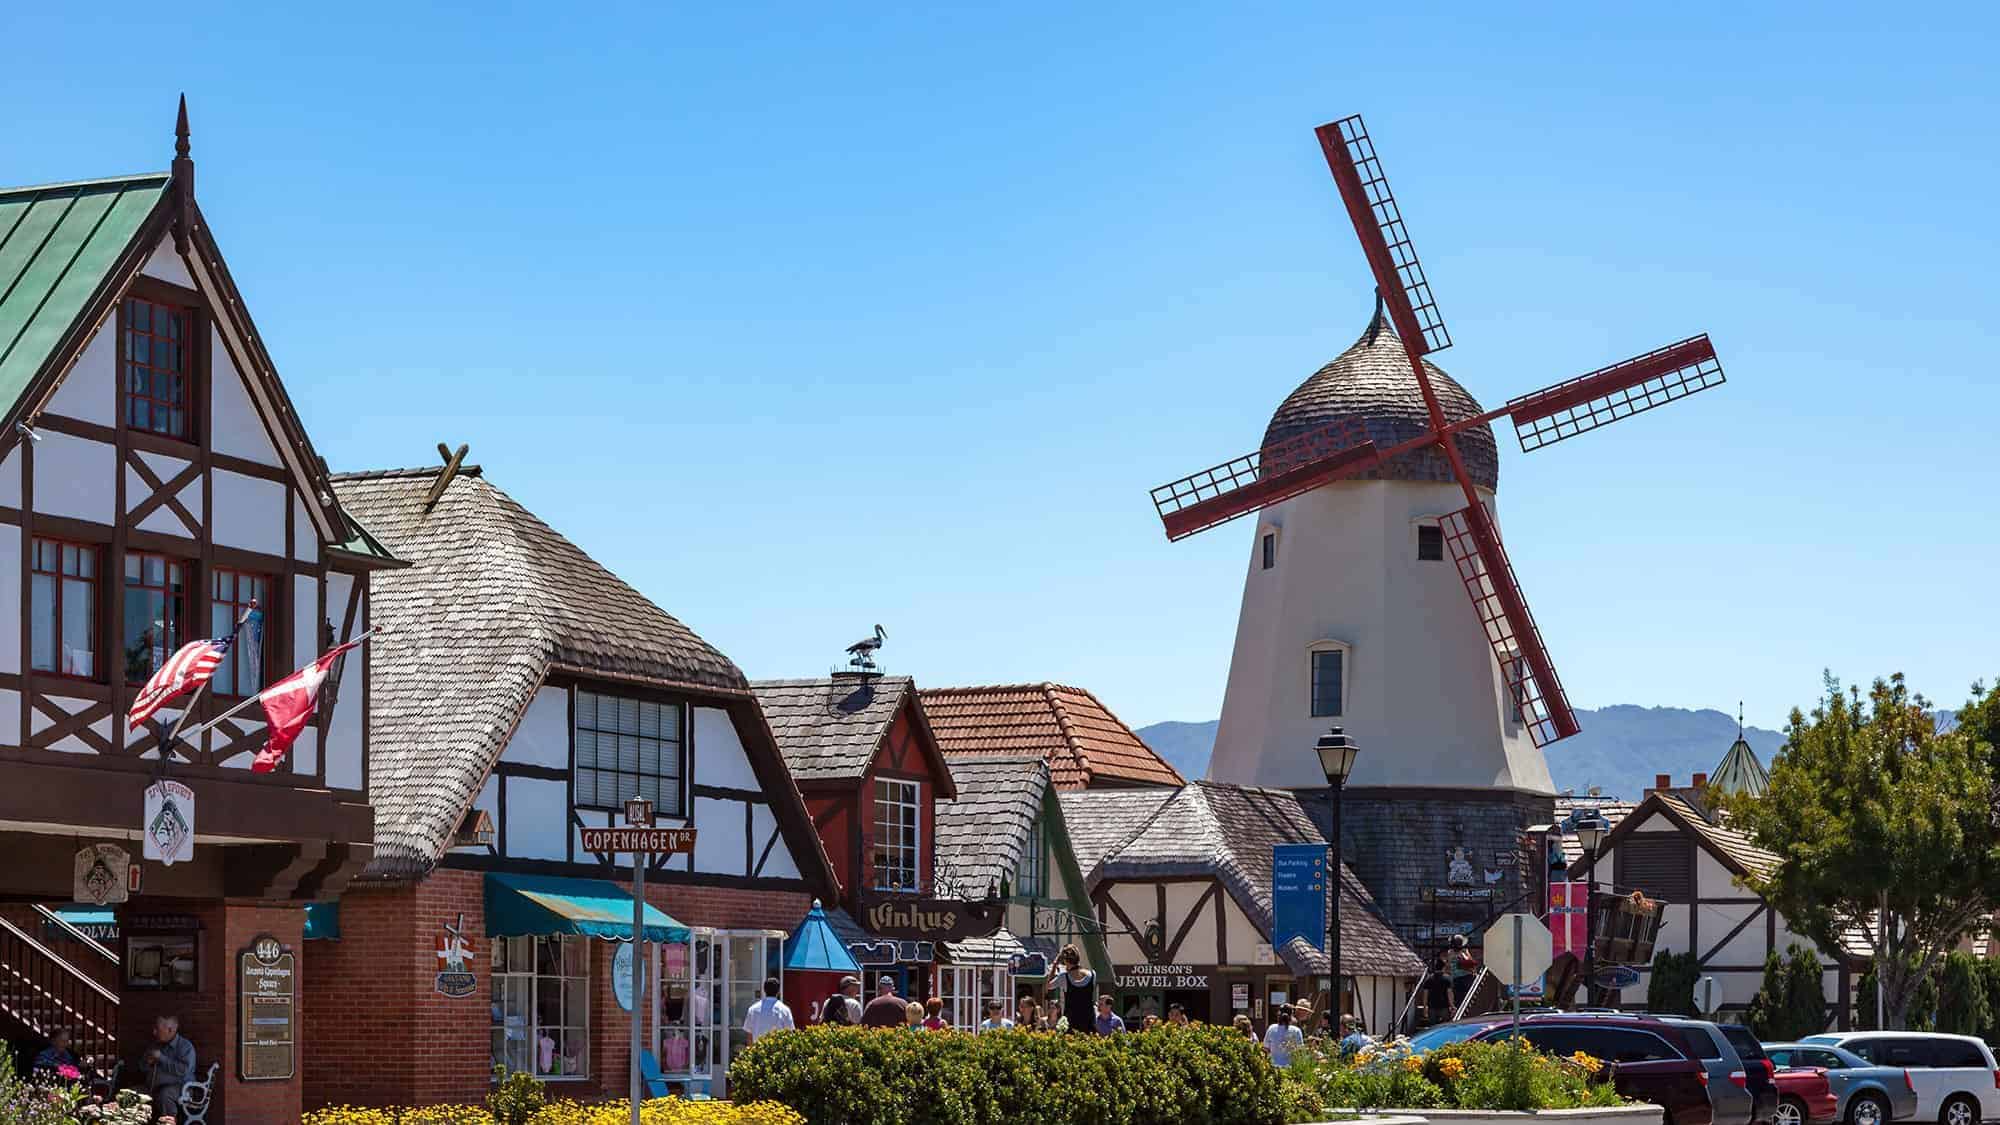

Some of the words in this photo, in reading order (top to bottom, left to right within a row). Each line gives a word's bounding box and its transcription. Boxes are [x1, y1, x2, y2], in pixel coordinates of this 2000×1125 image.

[584, 831, 677, 850] COPENHAGEN
[869, 902, 957, 932] Vinhus
[256, 942, 280, 958] 446
[1131, 965, 1193, 975] JOHNSON'S
[1115, 976, 1172, 988] JEWEL
[1176, 976, 1209, 988] BOX
